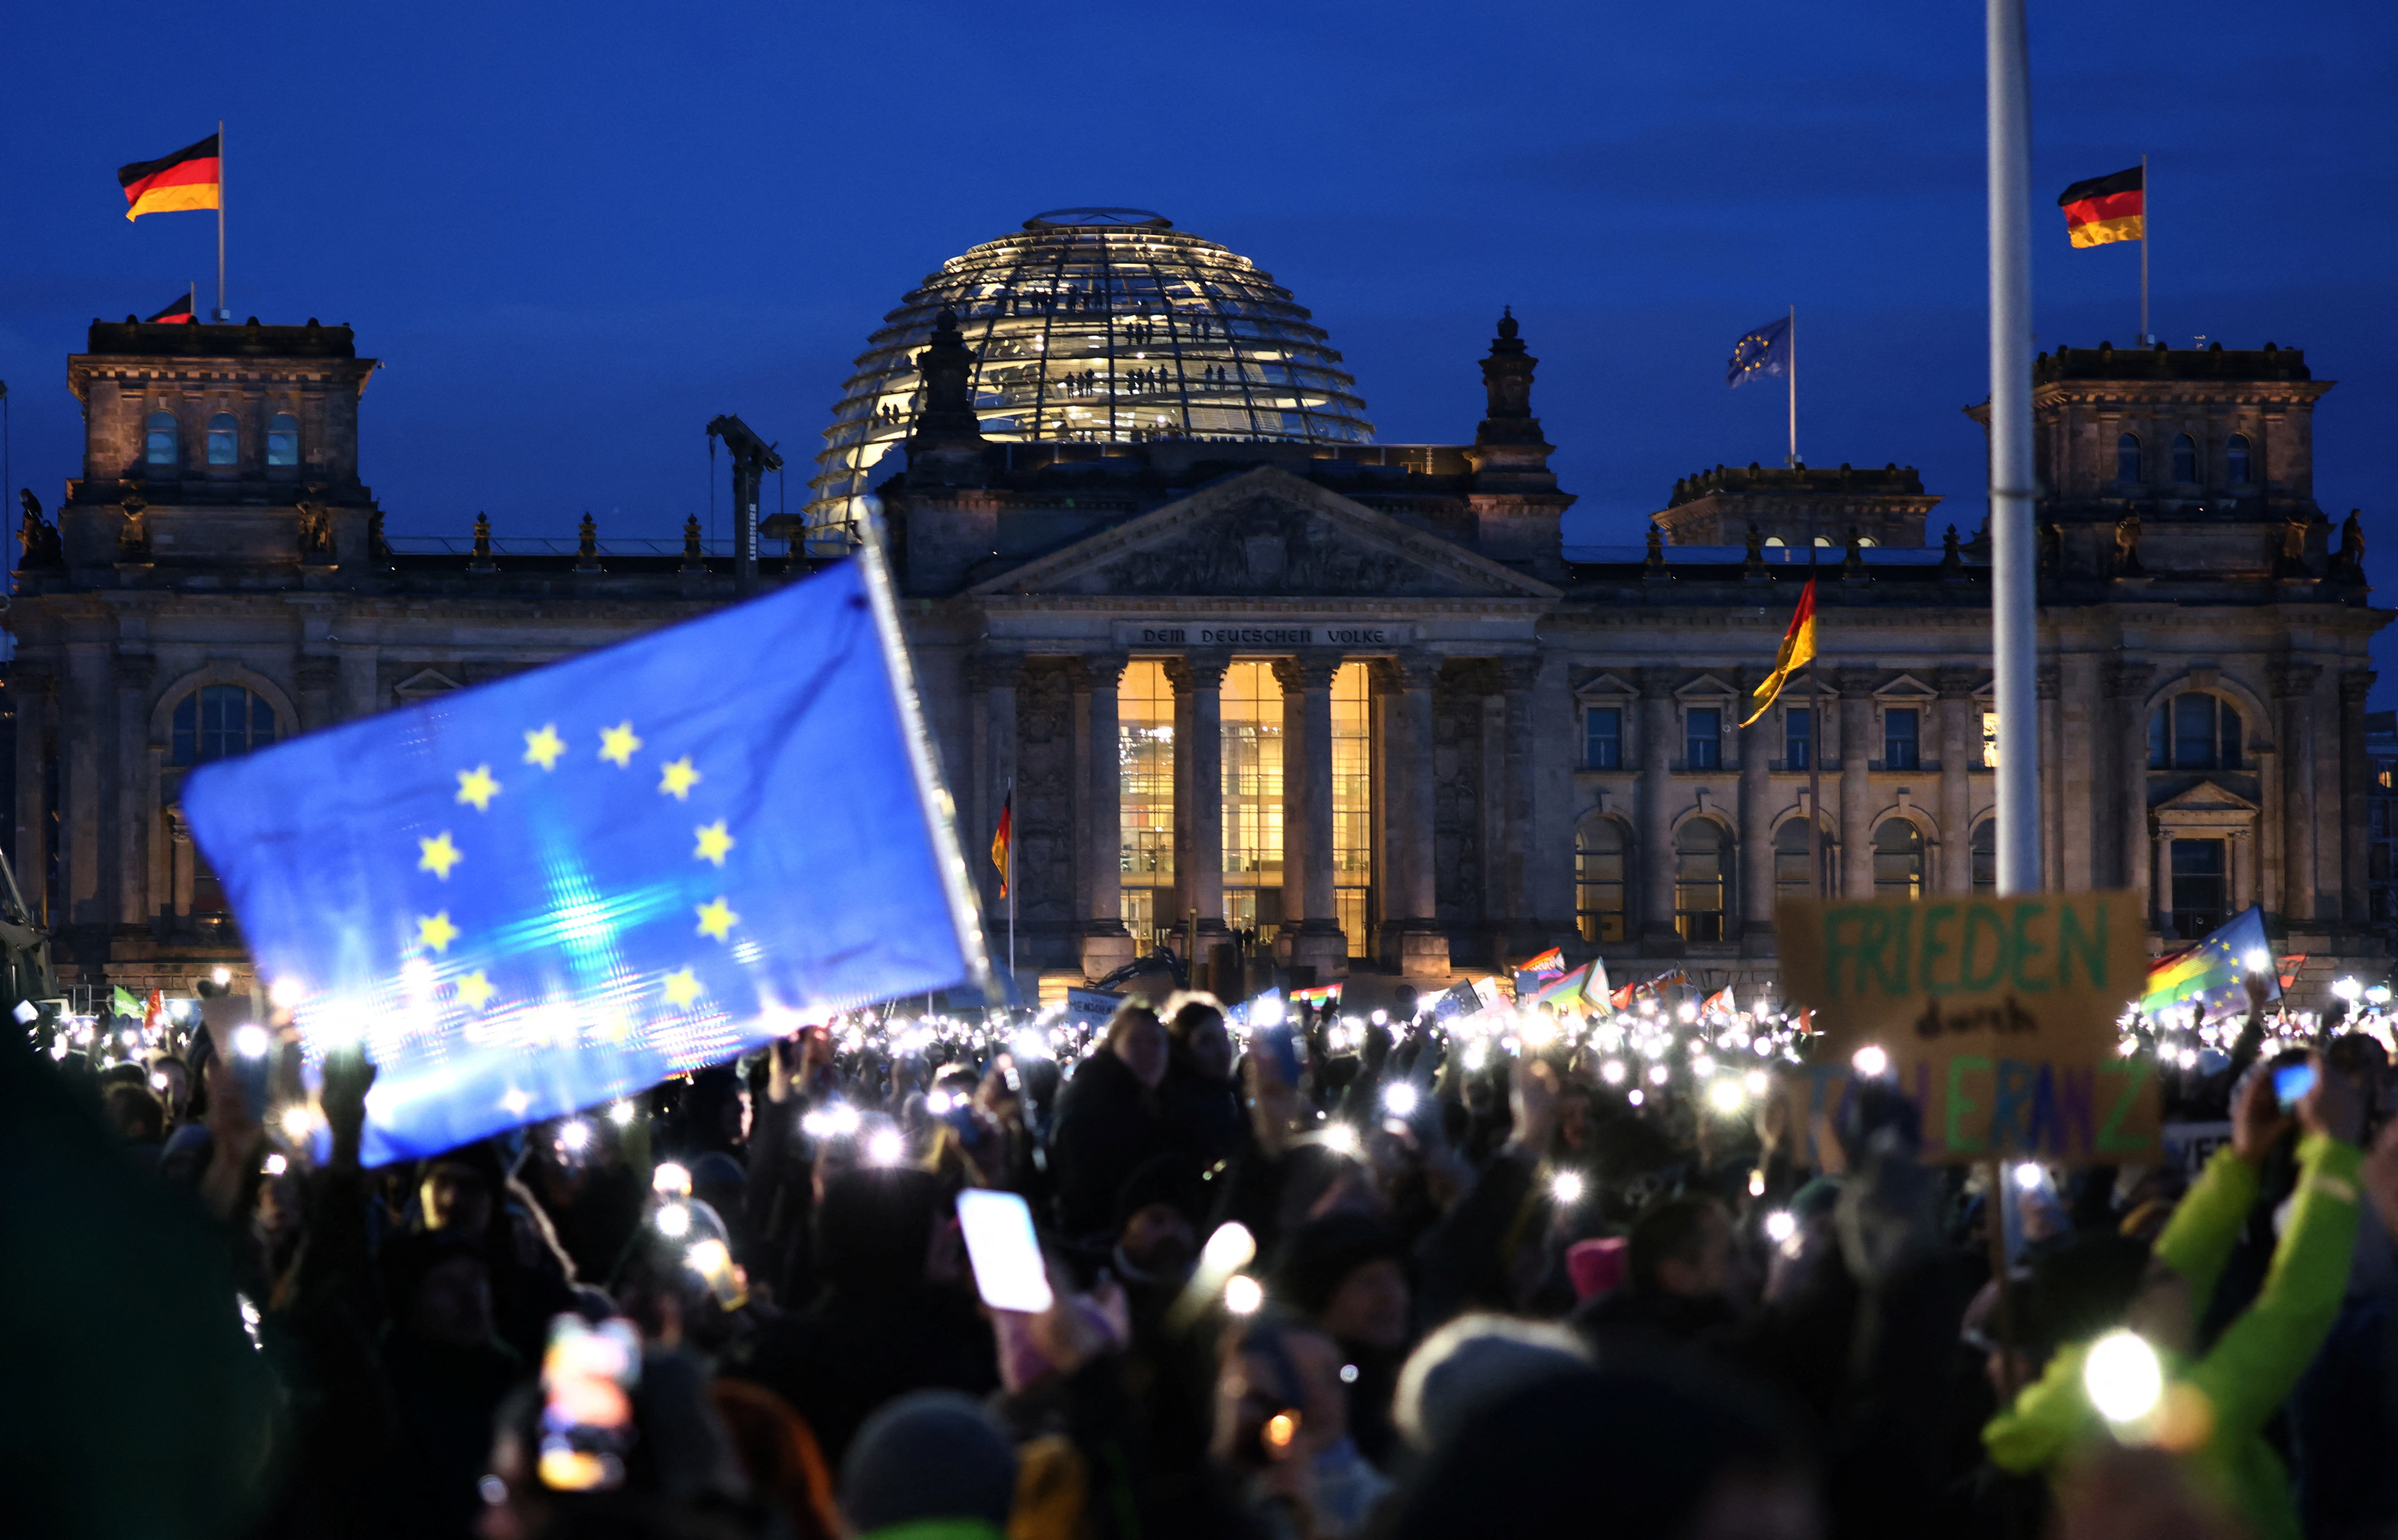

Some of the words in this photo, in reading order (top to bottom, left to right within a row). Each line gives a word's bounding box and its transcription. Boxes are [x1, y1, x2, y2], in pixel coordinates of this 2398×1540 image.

[1144, 629, 1185, 642] DEM
[1201, 630, 1311, 642] DEUTSCHEN
[1327, 630, 1383, 642] VOLKE
[1823, 901, 2109, 998] FRIEDEN
